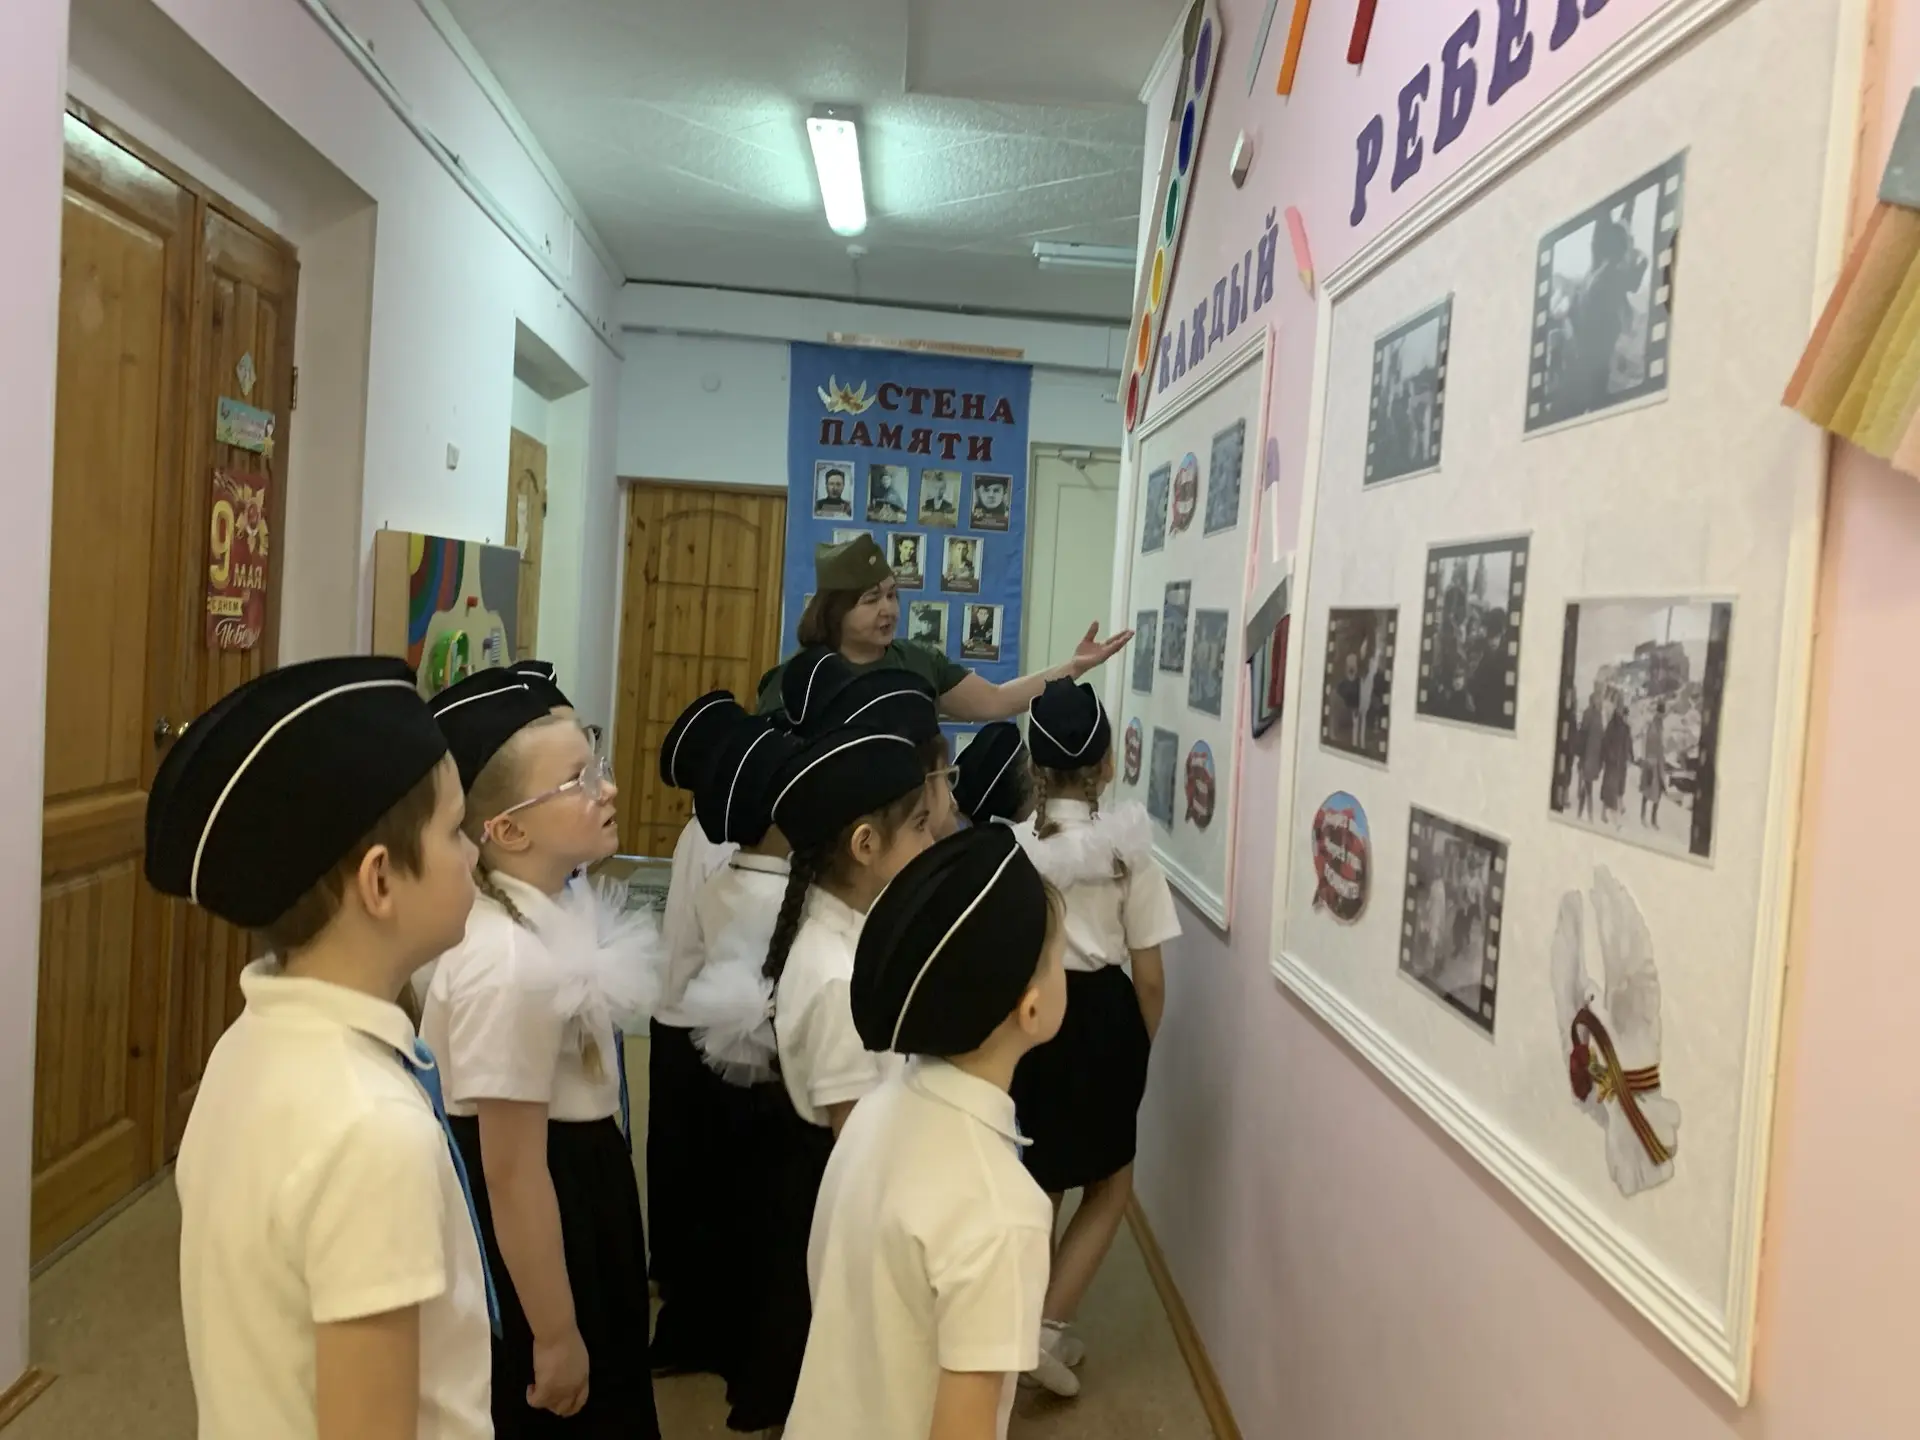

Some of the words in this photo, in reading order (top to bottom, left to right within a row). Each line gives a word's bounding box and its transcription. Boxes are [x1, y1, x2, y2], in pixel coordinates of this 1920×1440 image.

[1349, 0, 1610, 227] РЕБЕ
[1158, 206, 1279, 394] КАЖДЫЙ
[819, 418, 994, 462] ПАМЯТИ
[876, 382, 1015, 425] СТЕНА
[209, 500, 235, 590] 9
[232, 563, 263, 590] МАЯ
